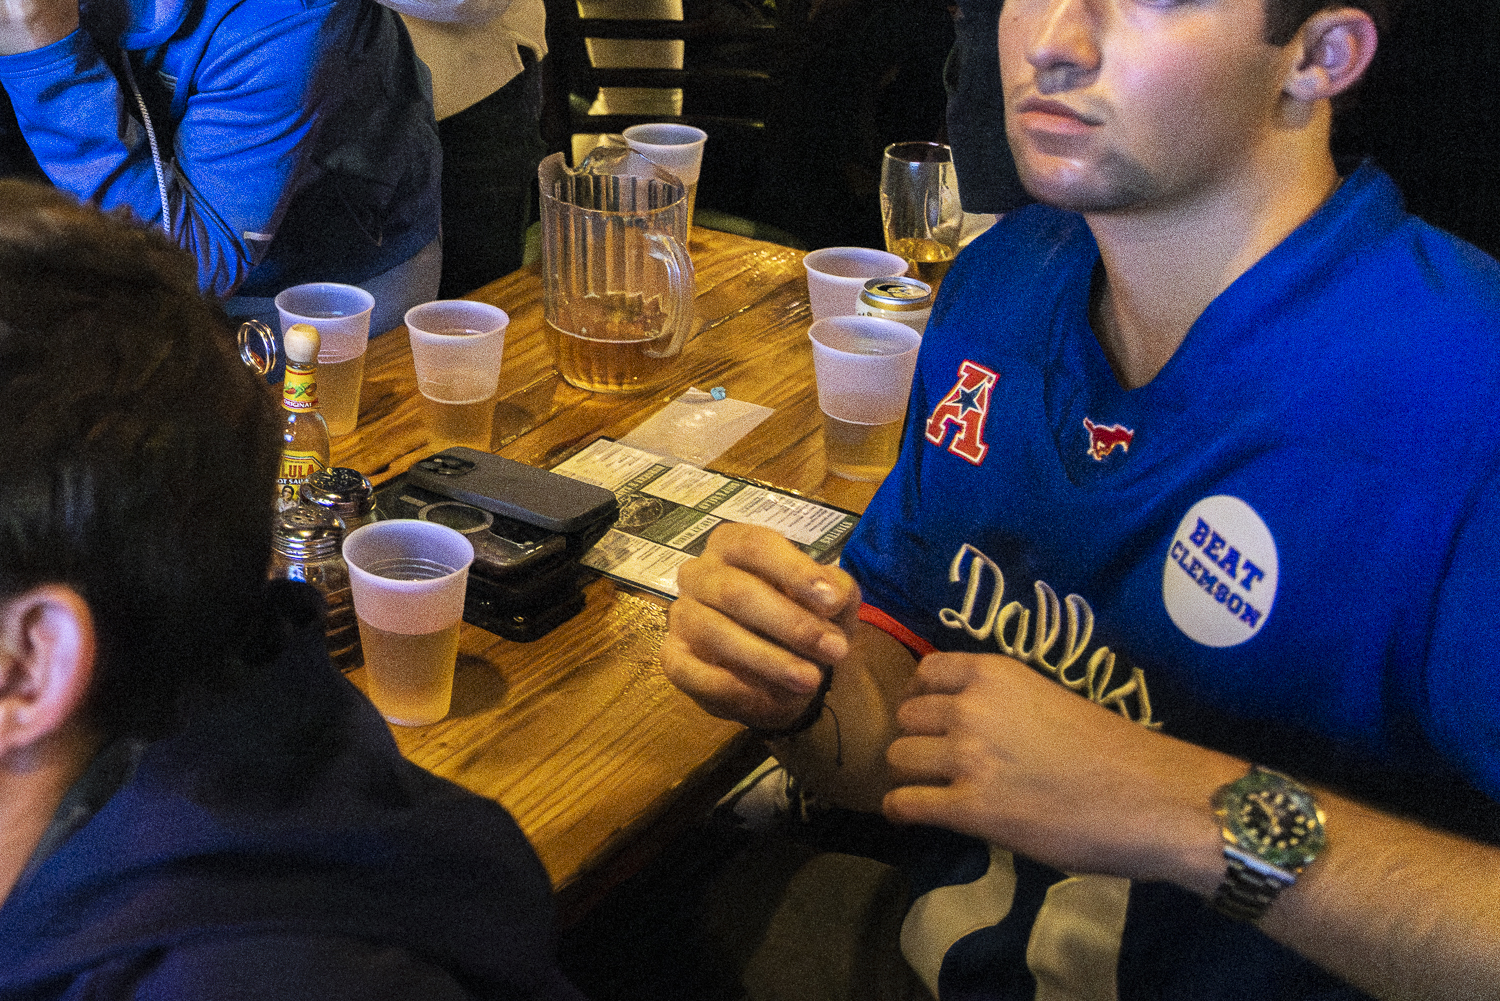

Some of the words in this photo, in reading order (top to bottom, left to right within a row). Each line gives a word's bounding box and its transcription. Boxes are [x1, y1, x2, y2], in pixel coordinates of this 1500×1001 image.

[925, 359, 1001, 467] A
[281, 464, 315, 478] LULA
[1171, 540, 1262, 628] CLEMSON
[1189, 517, 1264, 591] BEAT
[939, 543, 1163, 729] Dallas
